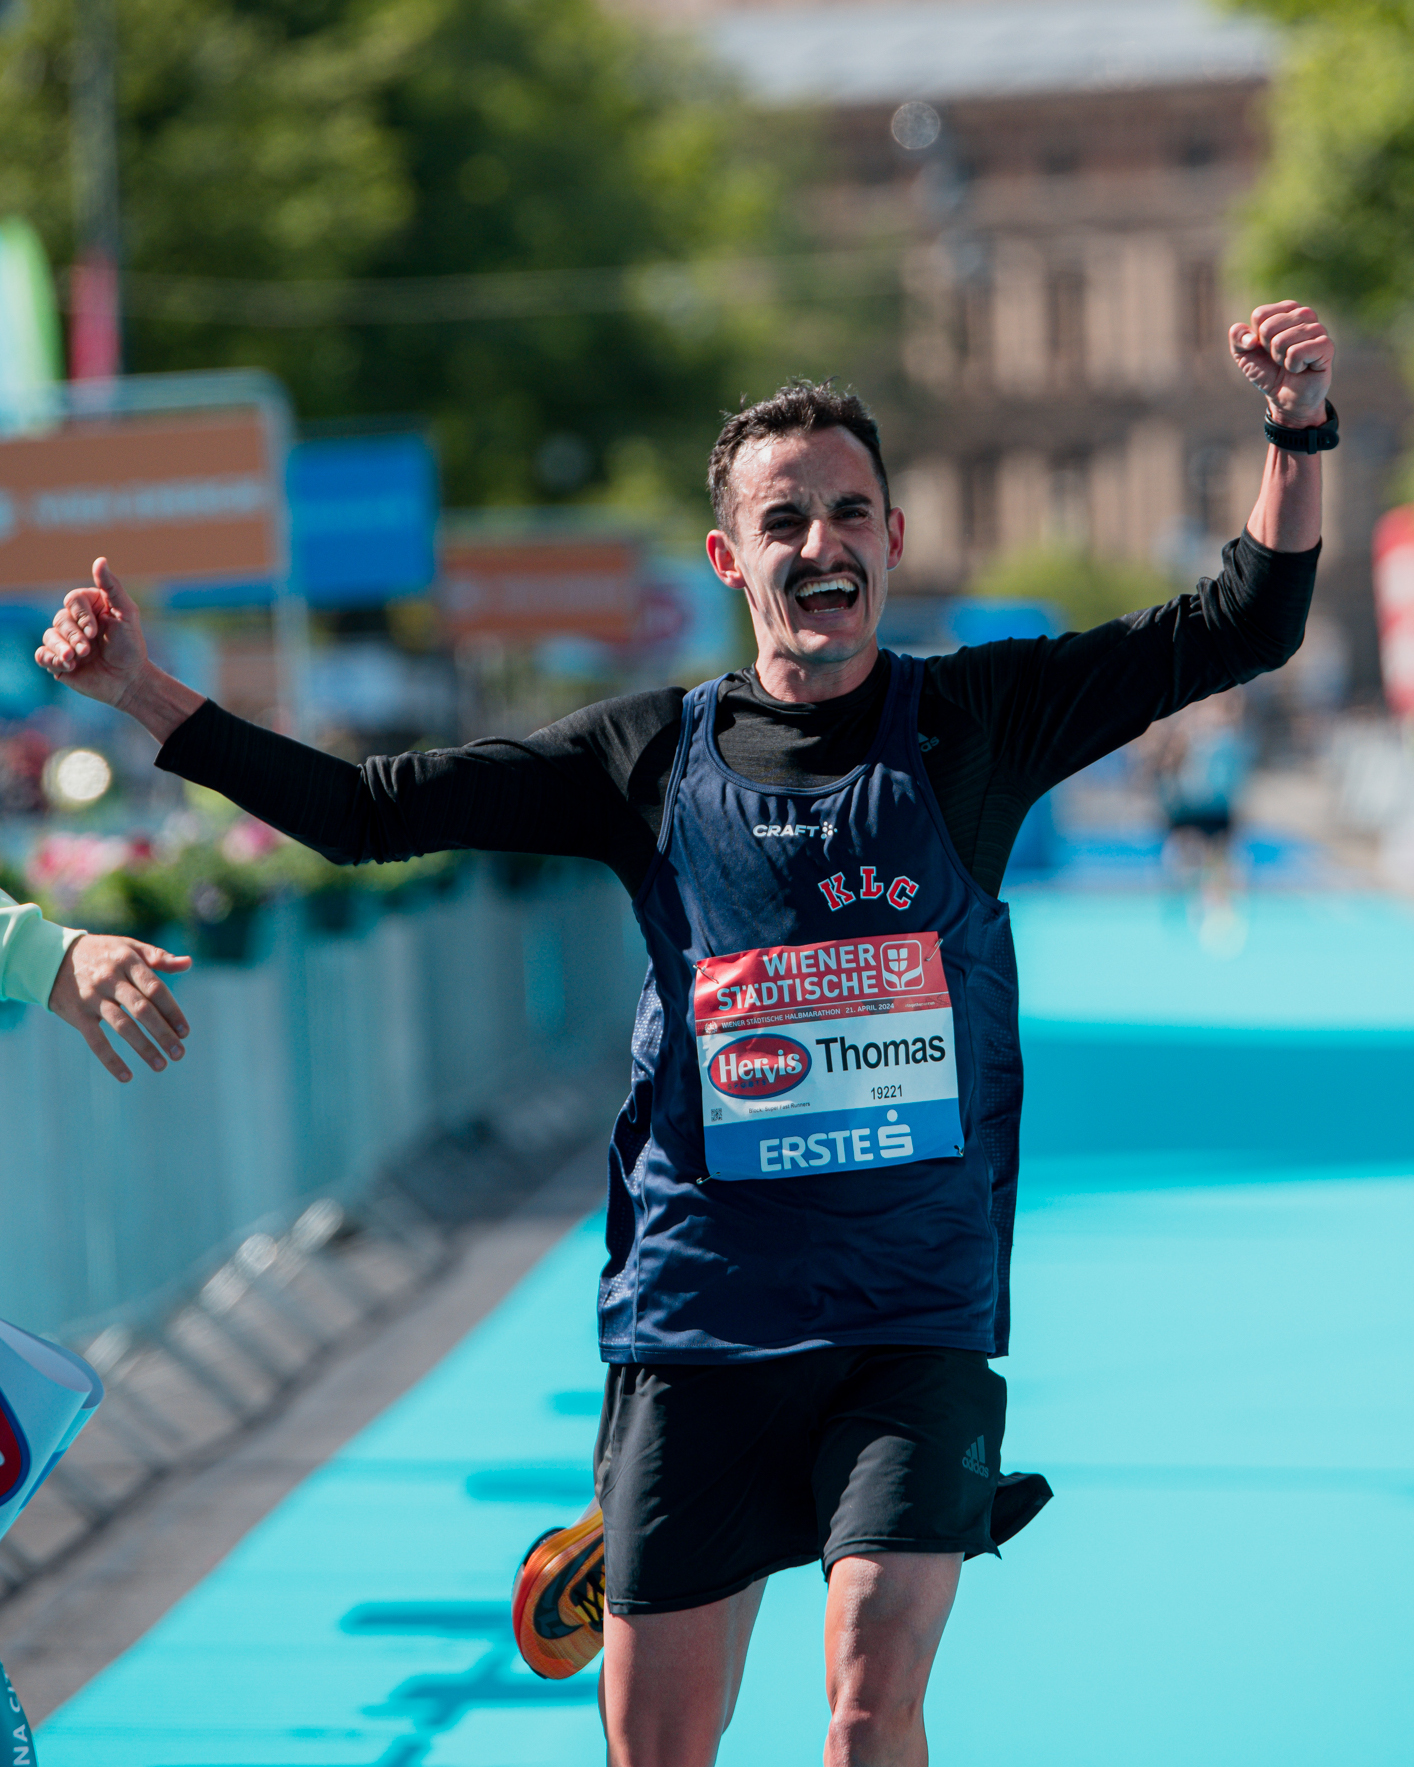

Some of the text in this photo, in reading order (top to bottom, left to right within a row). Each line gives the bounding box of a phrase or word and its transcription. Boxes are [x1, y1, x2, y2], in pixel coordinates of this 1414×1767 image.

[752, 824, 820, 838] CRAFT
[817, 866, 920, 912] KLC
[762, 943, 877, 977] WIENER
[716, 970, 879, 1011] STÄDTISCHE
[721, 1020, 746, 1029] WIENER
[746, 1014, 784, 1026] STÄDTISCHE
[784, 1008, 841, 1020] HALBMARATHON
[845, 1006, 857, 1014] 21.
[857, 1004, 878, 1012] APRIL
[718, 1034, 946, 1083] Hervis Thomas
[791, 1101, 811, 1109] Runners
[870, 1084, 903, 1100] 19221
[759, 1127, 874, 1173] ERSTE
